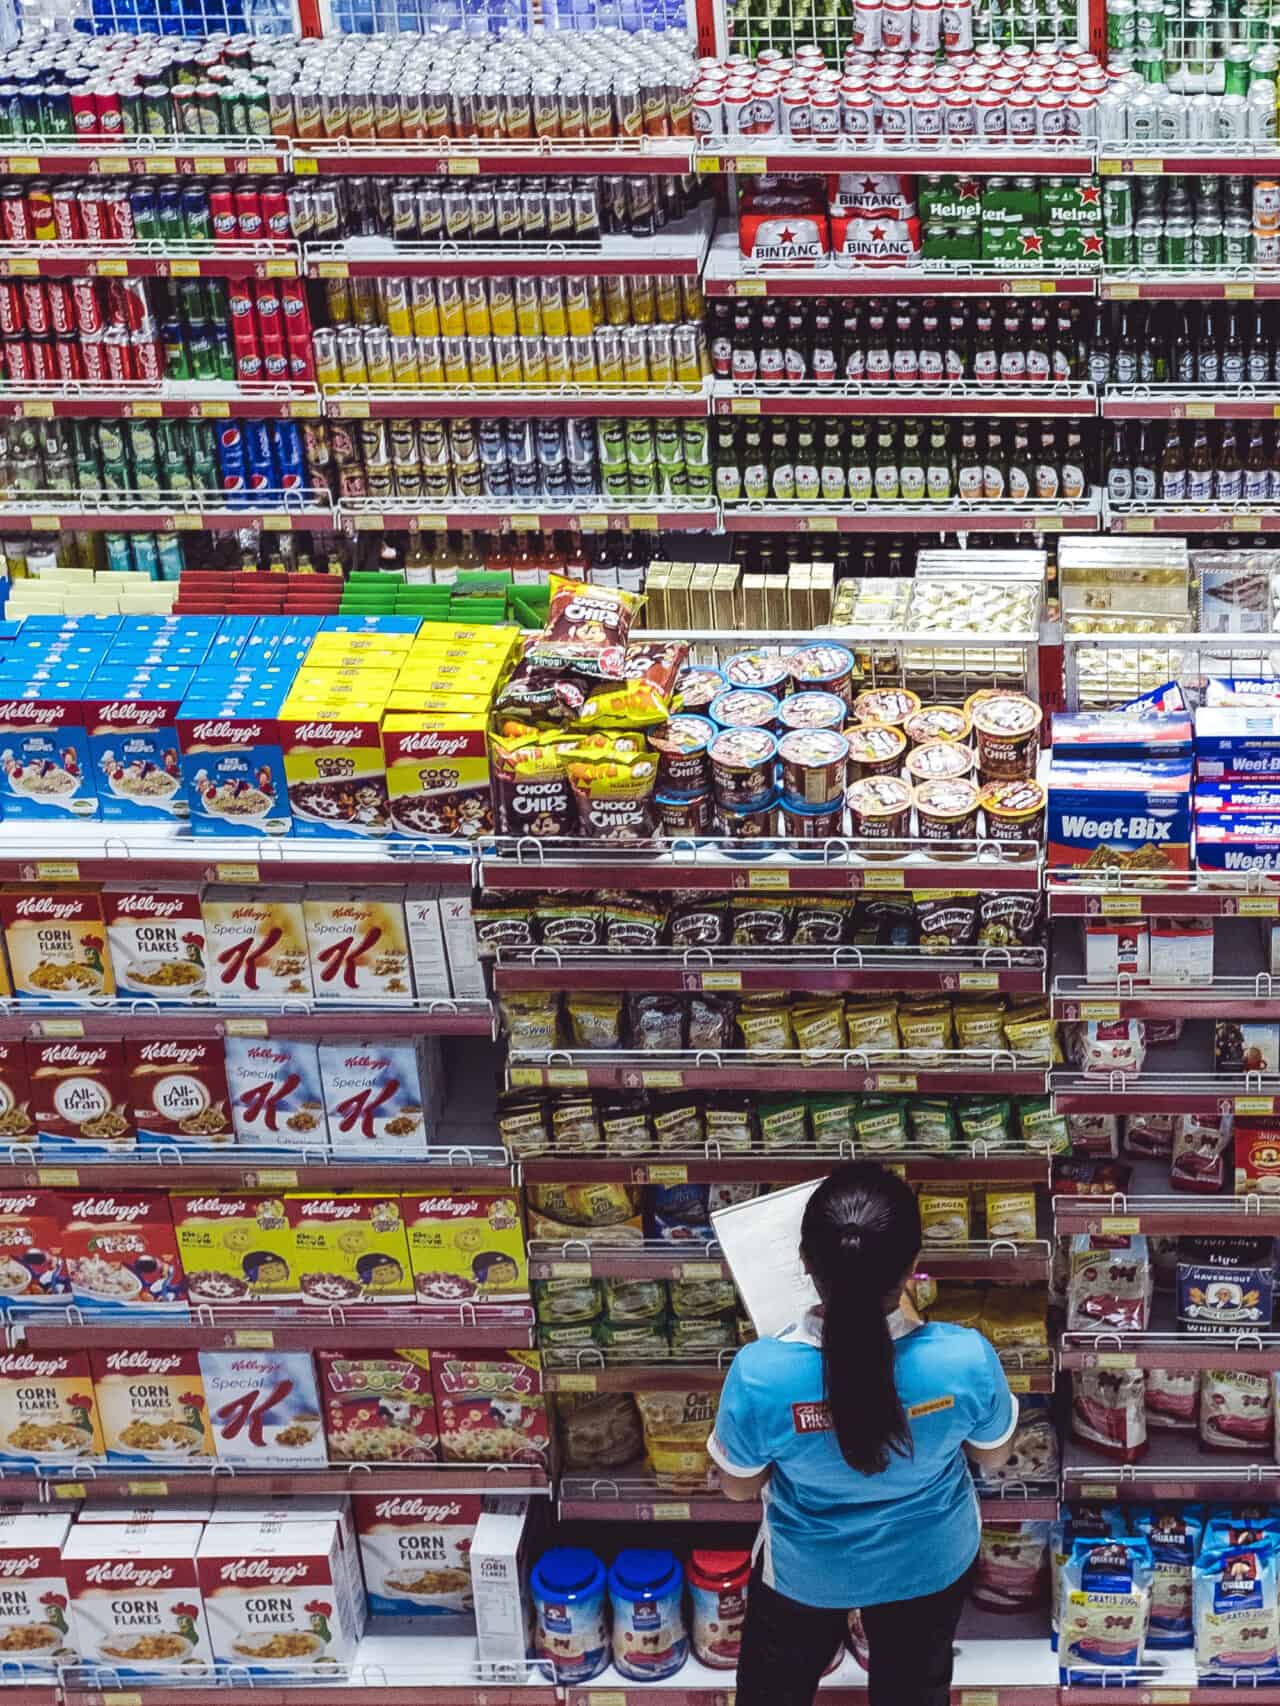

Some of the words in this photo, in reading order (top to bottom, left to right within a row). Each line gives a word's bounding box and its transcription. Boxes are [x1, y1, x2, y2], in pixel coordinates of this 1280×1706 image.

[99, 702, 166, 723] Kellogg's
[192, 721, 262, 744] Kellogg's
[294, 723, 364, 745] Kellogg's
[399, 733, 469, 754] Kellogg's
[516, 783, 562, 796] CHOCO
[512, 796, 568, 814] CHIPS
[591, 801, 637, 812] CHOCO
[589, 808, 644, 827] CHIPS
[1061, 815, 1172, 840] Weet-Bix
[15, 897, 84, 918] Kellogg's
[117, 895, 185, 916] Kellogg's
[135, 927, 177, 941] CORN
[212, 923, 257, 936] Special
[312, 922, 358, 934] Special
[37, 930, 71, 941] CORN
[39, 941, 74, 951] FLAKES
[137, 941, 179, 953] FLAKES
[217, 926, 283, 990] K
[317, 926, 382, 989] K
[41, 1044, 107, 1065] Kellogg's
[140, 1042, 206, 1064] Kellogg's
[248, 1047, 293, 1064] Kellogg's
[236, 1066, 278, 1080] Special
[332, 1076, 377, 1088] Special
[71, 1087, 94, 1100] All-
[170, 1085, 194, 1098] All-
[64, 1098, 101, 1110] Bran
[162, 1097, 200, 1108] Bran
[240, 1073, 302, 1131] K
[336, 1078, 401, 1139] K
[72, 1198, 150, 1221] Kellogg's
[186, 1200, 246, 1217] Kellogg's
[301, 1200, 361, 1217] Kellogg's
[418, 1198, 479, 1217] Kellogg's
[923, 1200, 964, 1211] ENERGEN
[1210, 1254, 1240, 1265] Ligo
[1194, 1272, 1252, 1284] HAVERMOUT
[106, 1350, 181, 1374] Kellogg's
[210, 1377, 265, 1390] Special
[16, 1387, 56, 1400] CORN
[128, 1385, 170, 1398] CORN
[19, 1399, 60, 1410] FLAKES
[131, 1397, 172, 1409] FLAKES
[217, 1379, 294, 1447] K
[375, 1498, 462, 1521] Kellogg's
[398, 1536, 445, 1549] CORN
[400, 1550, 447, 1561] FLAKES
[86, 1561, 175, 1586] Kellogg's
[220, 1560, 309, 1584] Kellogg's
[111, 1600, 159, 1614] CORN
[245, 1598, 293, 1613] CORN
[114, 1614, 162, 1626] FLAKES
[248, 1612, 296, 1624] FLAKES
